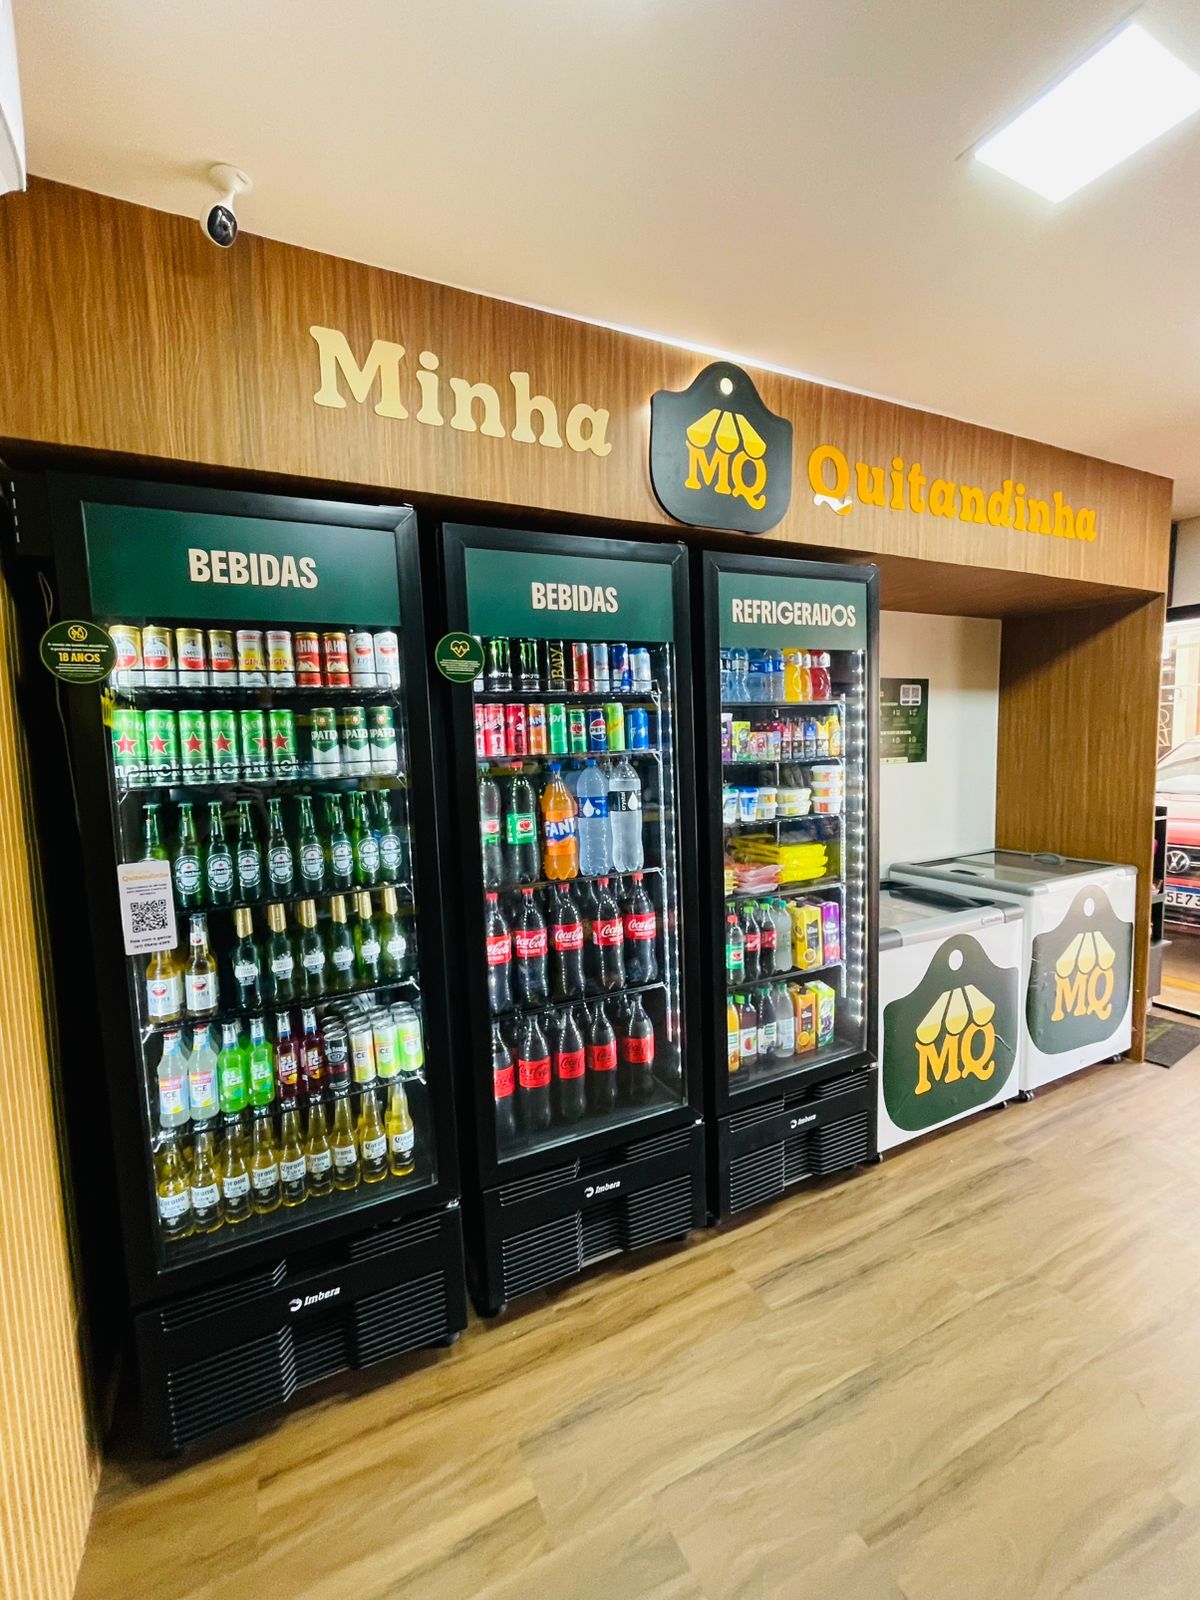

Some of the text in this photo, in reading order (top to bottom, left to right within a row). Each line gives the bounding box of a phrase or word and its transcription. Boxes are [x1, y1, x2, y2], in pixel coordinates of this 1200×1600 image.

[309, 325, 612, 457] Minha
[684, 439, 767, 511] MQ
[808, 444, 1097, 542] Quitandinha
[188, 548, 319, 589] BEBIDAS
[531, 581, 619, 613] BEBIDAS
[732, 598, 856, 627] REFRIGERADOS
[58, 652, 101, 663] 18 ANOS
[549, 648, 564, 680] BALY
[545, 817, 576, 838] FANT
[1051, 966, 1115, 1022] MQ
[915, 1021, 996, 1095] MQ
[304, 1286, 341, 1307] Imbera
